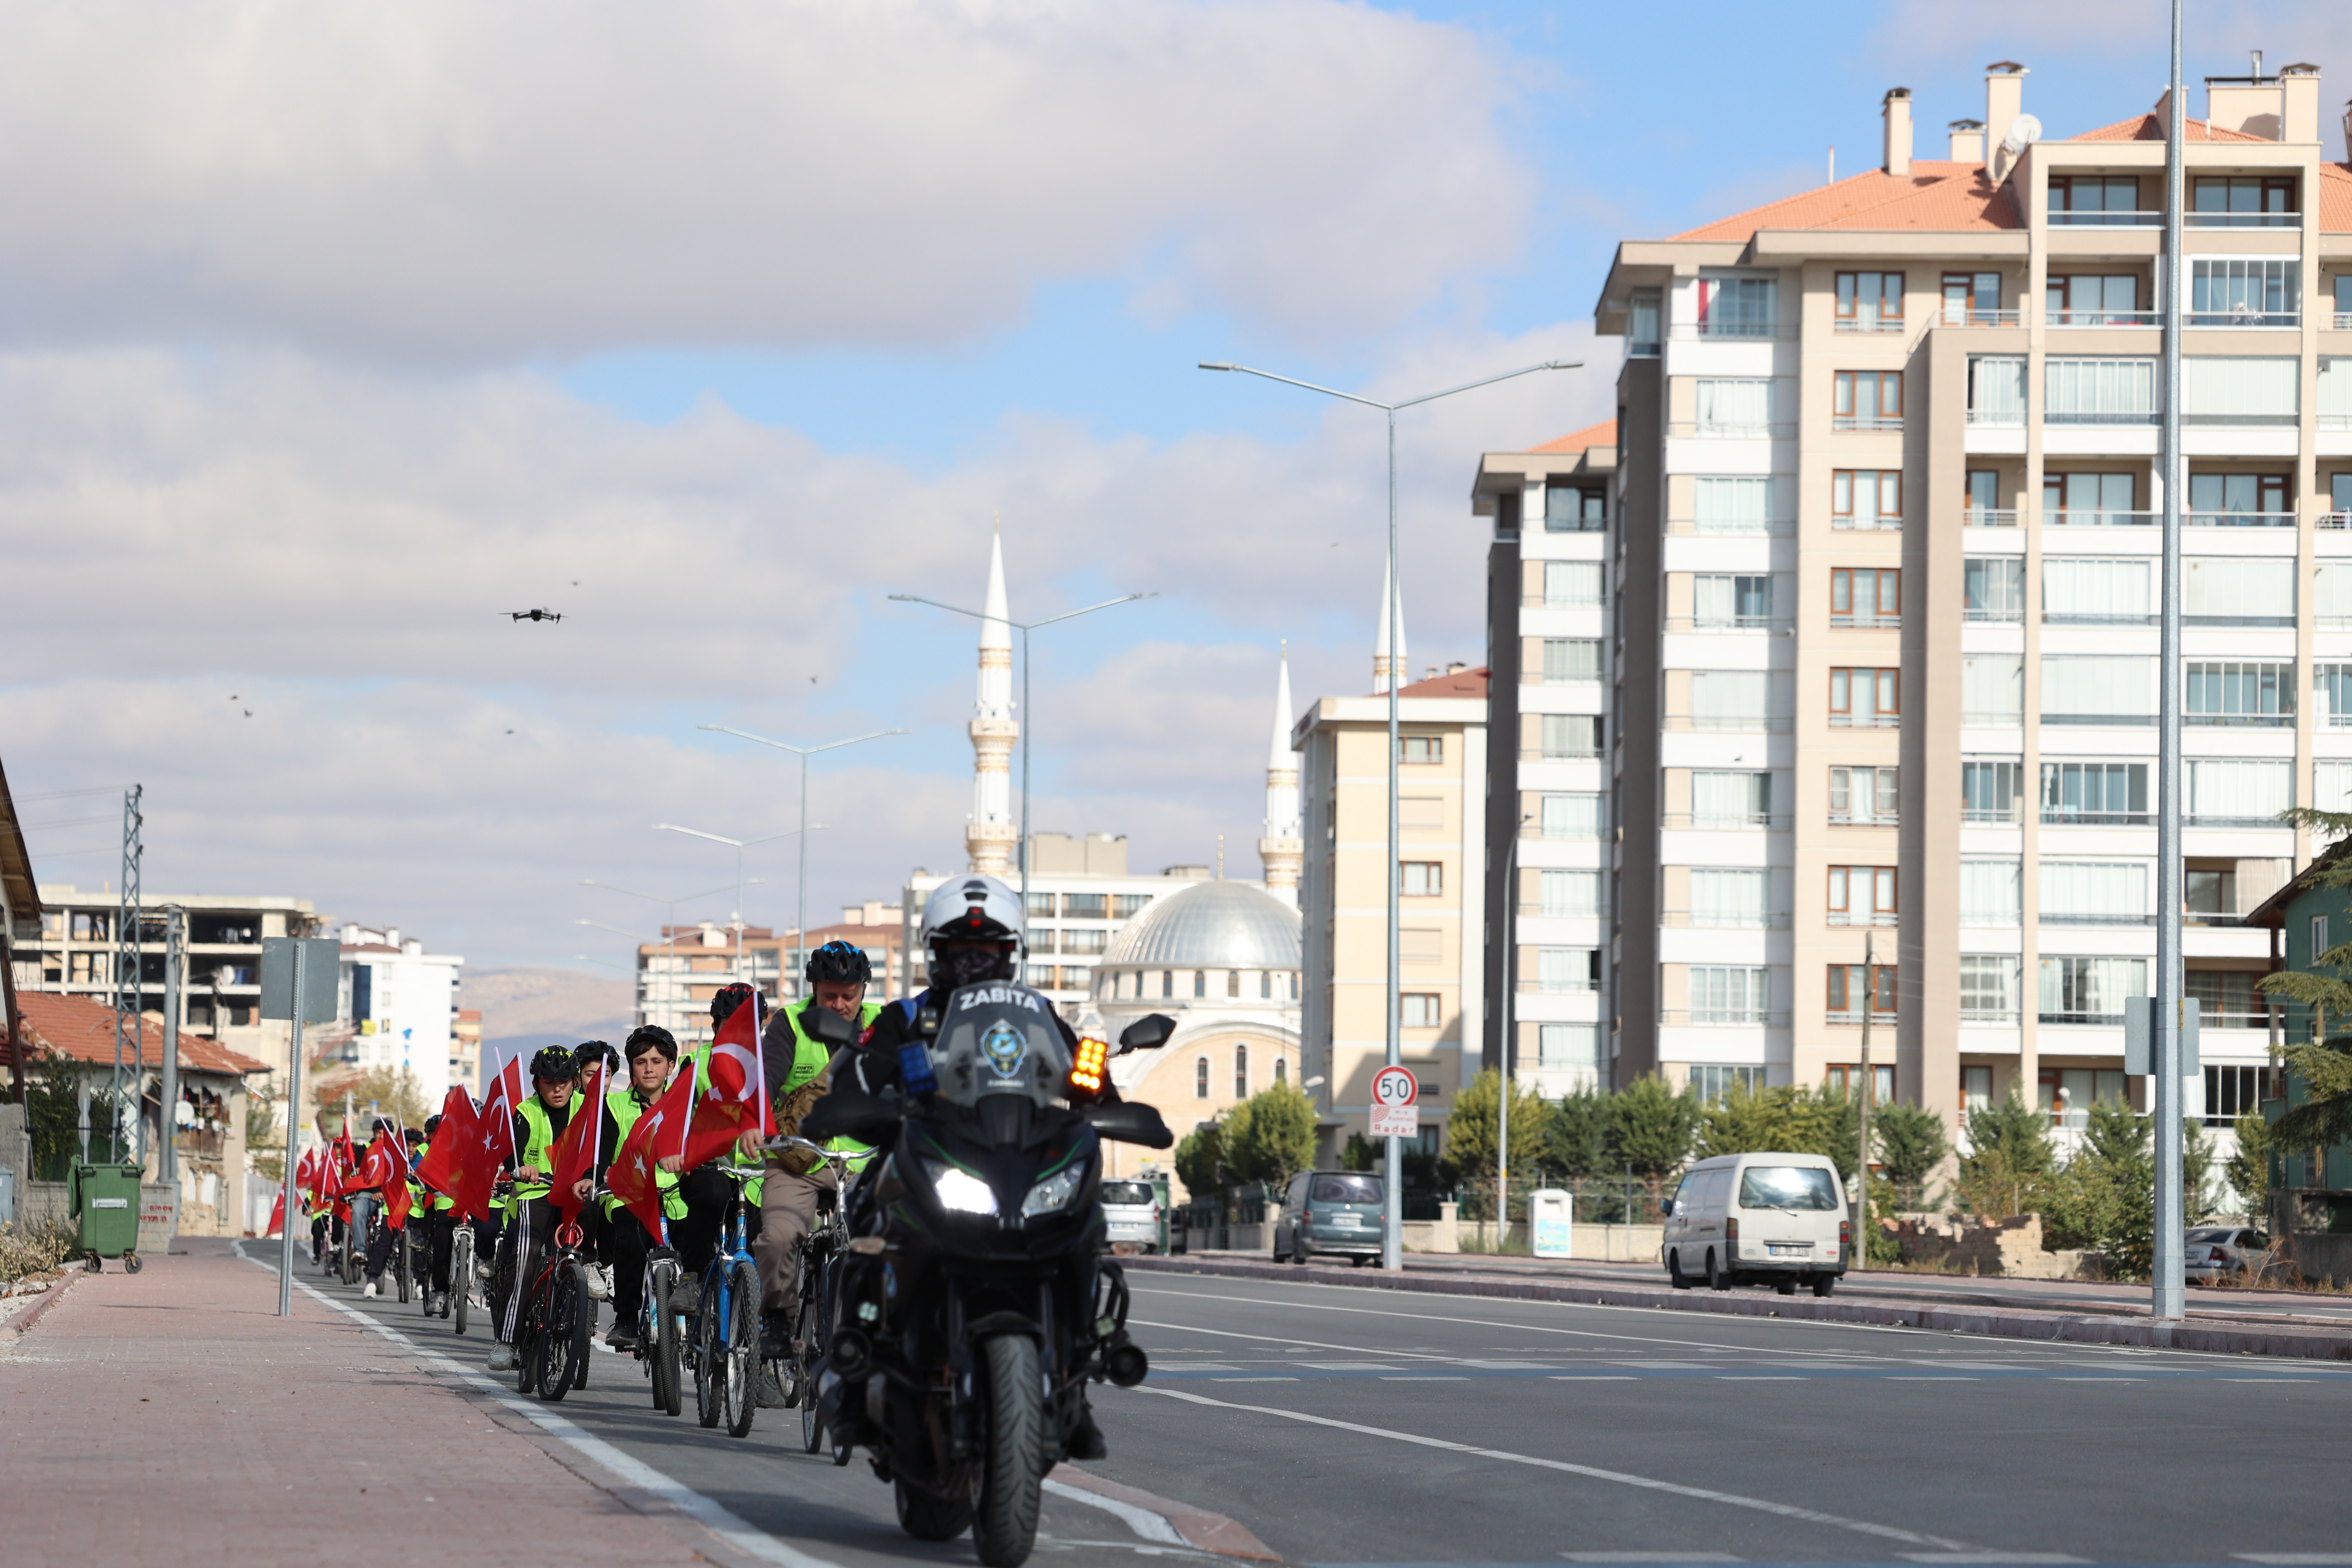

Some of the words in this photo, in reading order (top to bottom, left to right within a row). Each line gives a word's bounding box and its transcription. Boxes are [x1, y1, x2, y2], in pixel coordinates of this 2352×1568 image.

[960, 987, 1040, 1013] ZABITA
[1381, 1078, 1409, 1098] 50
[1375, 1124, 1414, 1133] Radar
